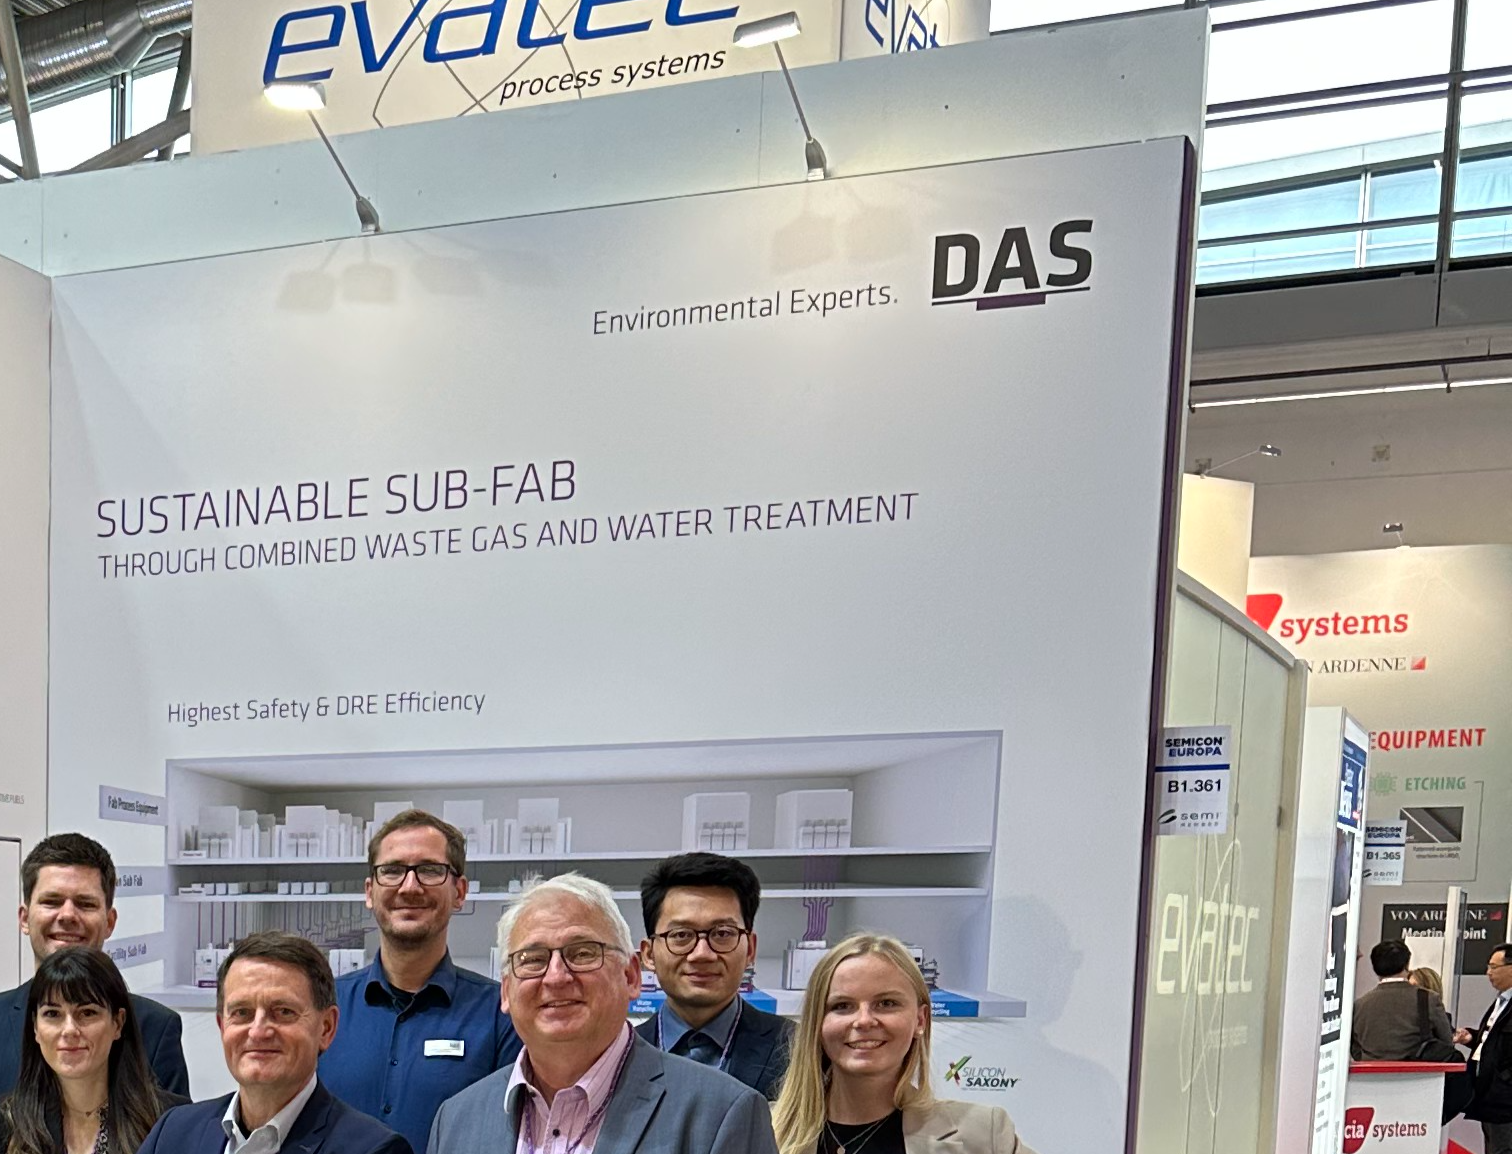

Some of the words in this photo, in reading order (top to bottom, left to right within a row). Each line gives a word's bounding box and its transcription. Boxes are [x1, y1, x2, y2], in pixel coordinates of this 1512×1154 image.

[500, 67, 603, 105] process
[610, 50, 727, 88] systems
[932, 218, 1094, 299] DAS
[592, 290, 780, 336] Environmental
[790, 284, 899, 319] Experts.
[96, 477, 370, 539] SUSTAINABLE
[385, 459, 576, 515] SUB-FAB
[98, 547, 216, 579] THROUGH
[223, 536, 356, 571] COMBINED
[364, 527, 462, 560] WASTE
[471, 522, 528, 553] GAS
[536, 517, 598, 548] AND
[606, 508, 714, 542] WATER
[723, 492, 920, 534] TREATMENT
[1279, 611, 1409, 645] systems
[1317, 656, 1407, 674] ARDENNE
[167, 701, 241, 728] Highest
[246, 698, 311, 723] Safety
[316, 696, 330, 718] &
[336, 694, 379, 716] DRE
[385, 690, 486, 715] Efficiency
[1165, 736, 1223, 748] SEMICON
[1369, 728, 1487, 752] EQUIPMENT
[1168, 747, 1222, 757] EUROPA
[1167, 778, 1222, 793] B1.361
[1405, 776, 1467, 792] ETCHING
[1390, 910, 1419, 921] VON
[1156, 883, 1260, 995] evatec
[1401, 926, 1445, 940] Meetin
[1462, 926, 1487, 940] oint
[962, 1066, 1007, 1078] SILICON
[965, 1077, 1019, 1088] SAXONY
[1344, 1120, 1365, 1139] cia
[1372, 1121, 1428, 1143] systems
